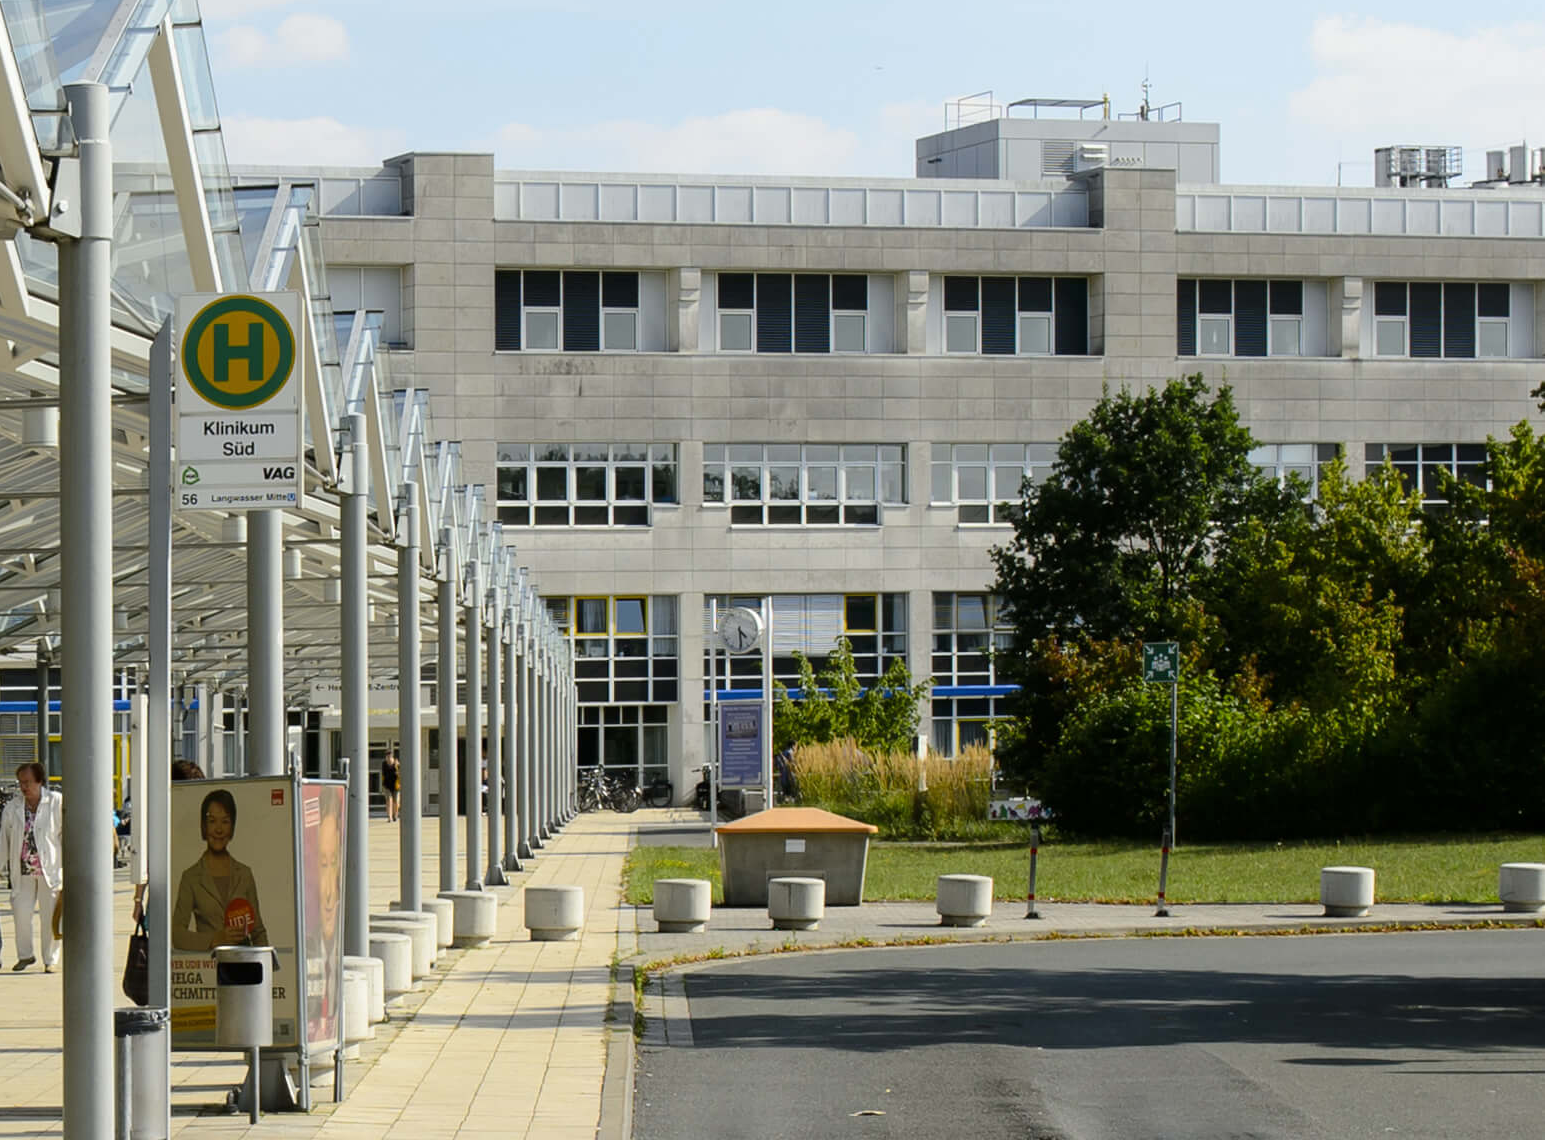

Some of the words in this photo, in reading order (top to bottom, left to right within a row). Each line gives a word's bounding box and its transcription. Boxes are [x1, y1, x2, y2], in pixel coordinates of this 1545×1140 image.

[213, 323, 264, 382] H
[203, 421, 275, 436] Klinikum
[223, 442, 255, 456] Süd
[263, 467, 295, 480] VAG
[182, 494, 198, 505] 56
[211, 494, 263, 503] Langwasser
[266, 492, 286, 501] Mitte
